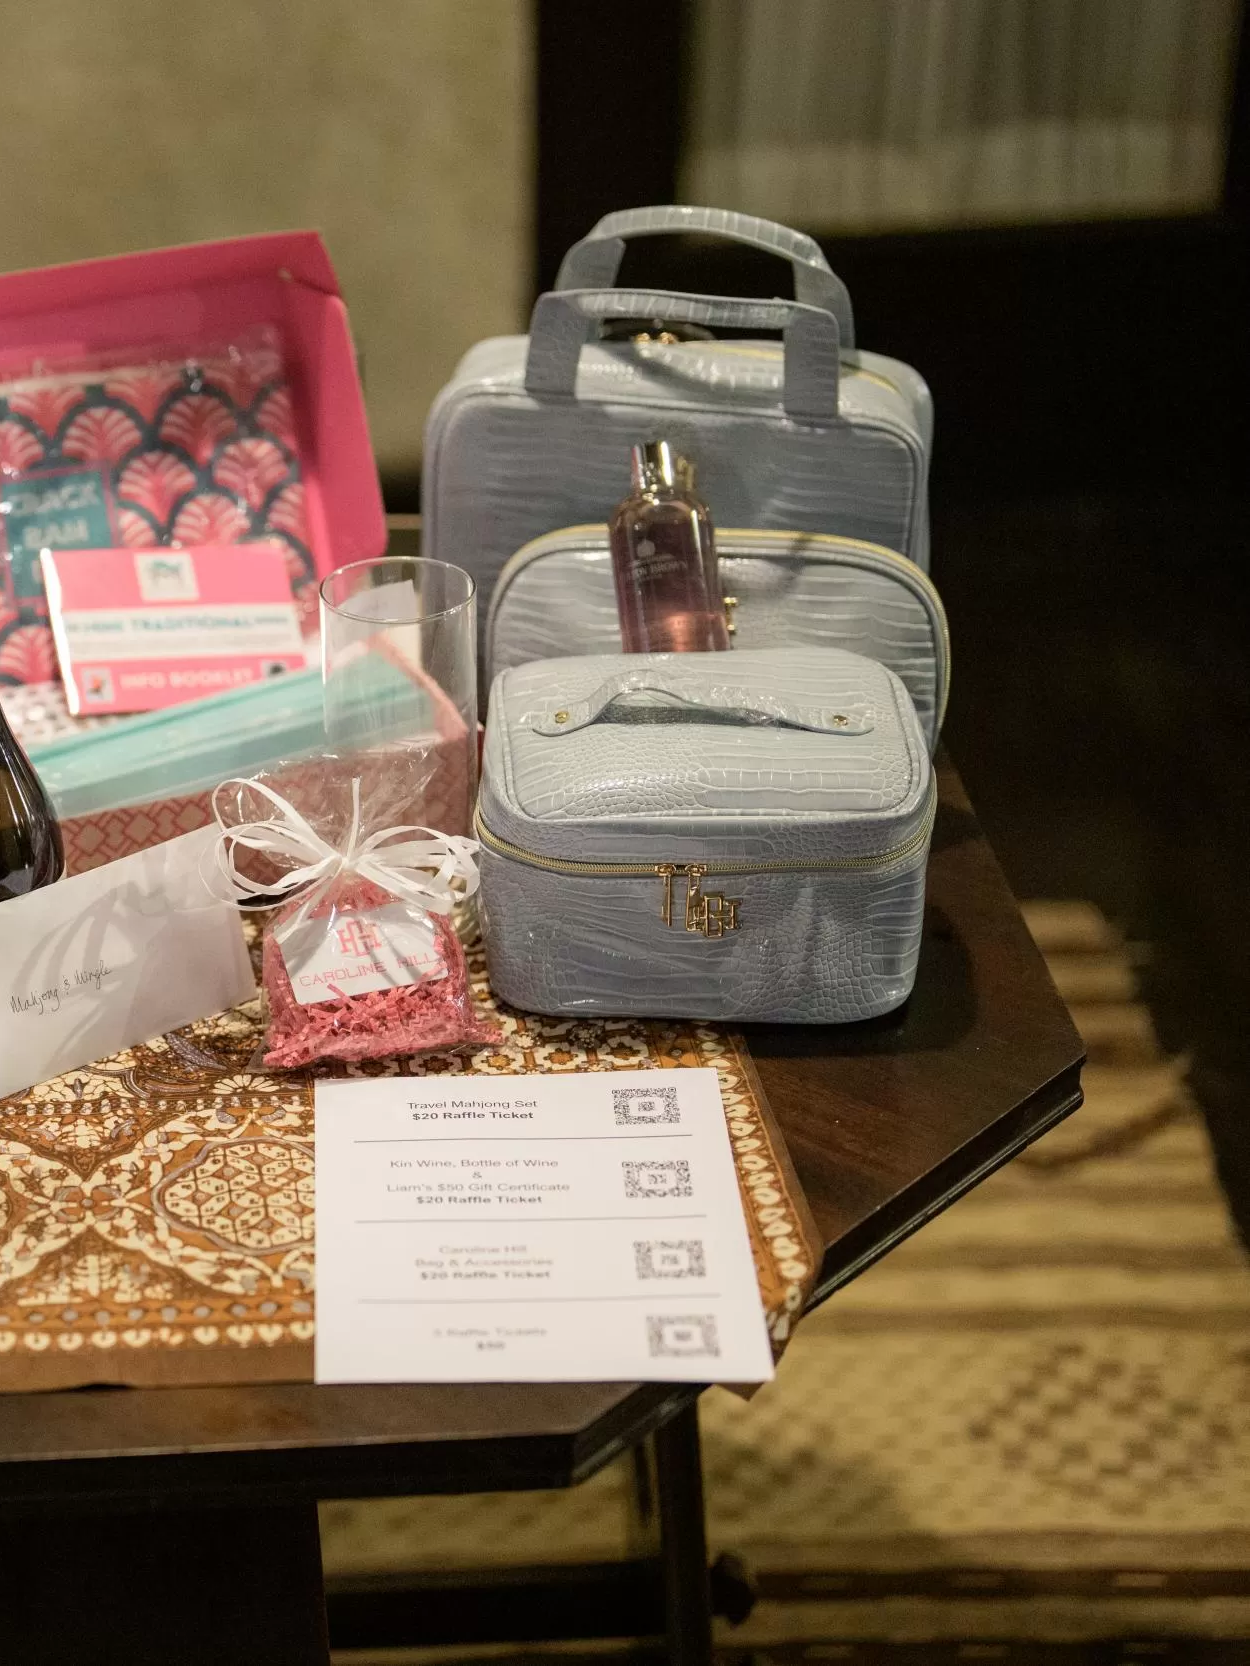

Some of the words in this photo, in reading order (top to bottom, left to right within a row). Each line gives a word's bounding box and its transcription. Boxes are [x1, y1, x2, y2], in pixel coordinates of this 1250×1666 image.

[299, 962, 386, 987] CAROLINE
[398, 953, 437, 968] HILL
[10, 989, 60, 1015] Mahjong
[407, 1101, 447, 1109] Travel
[451, 1100, 510, 1110] Mahjong
[514, 1100, 538, 1108] Set
[412, 1112, 439, 1121] $20
[443, 1111, 486, 1119] Raffle
[489, 1111, 534, 1119] Ticket
[390, 1160, 412, 1168] Kin
[417, 1159, 456, 1169] Wine,
[461, 1159, 501, 1168] Bottle
[505, 1159, 518, 1167] of
[523, 1159, 559, 1167] Wine
[472, 1171, 483, 1179] &
[387, 1184, 432, 1192] Liam's
[437, 1183, 464, 1192] $50
[468, 1183, 493, 1191] Gift
[497, 1183, 570, 1191] Certificate
[416, 1196, 443, 1205] $20
[448, 1196, 491, 1204] Raffle
[496, 1196, 543, 1204] Ticket
